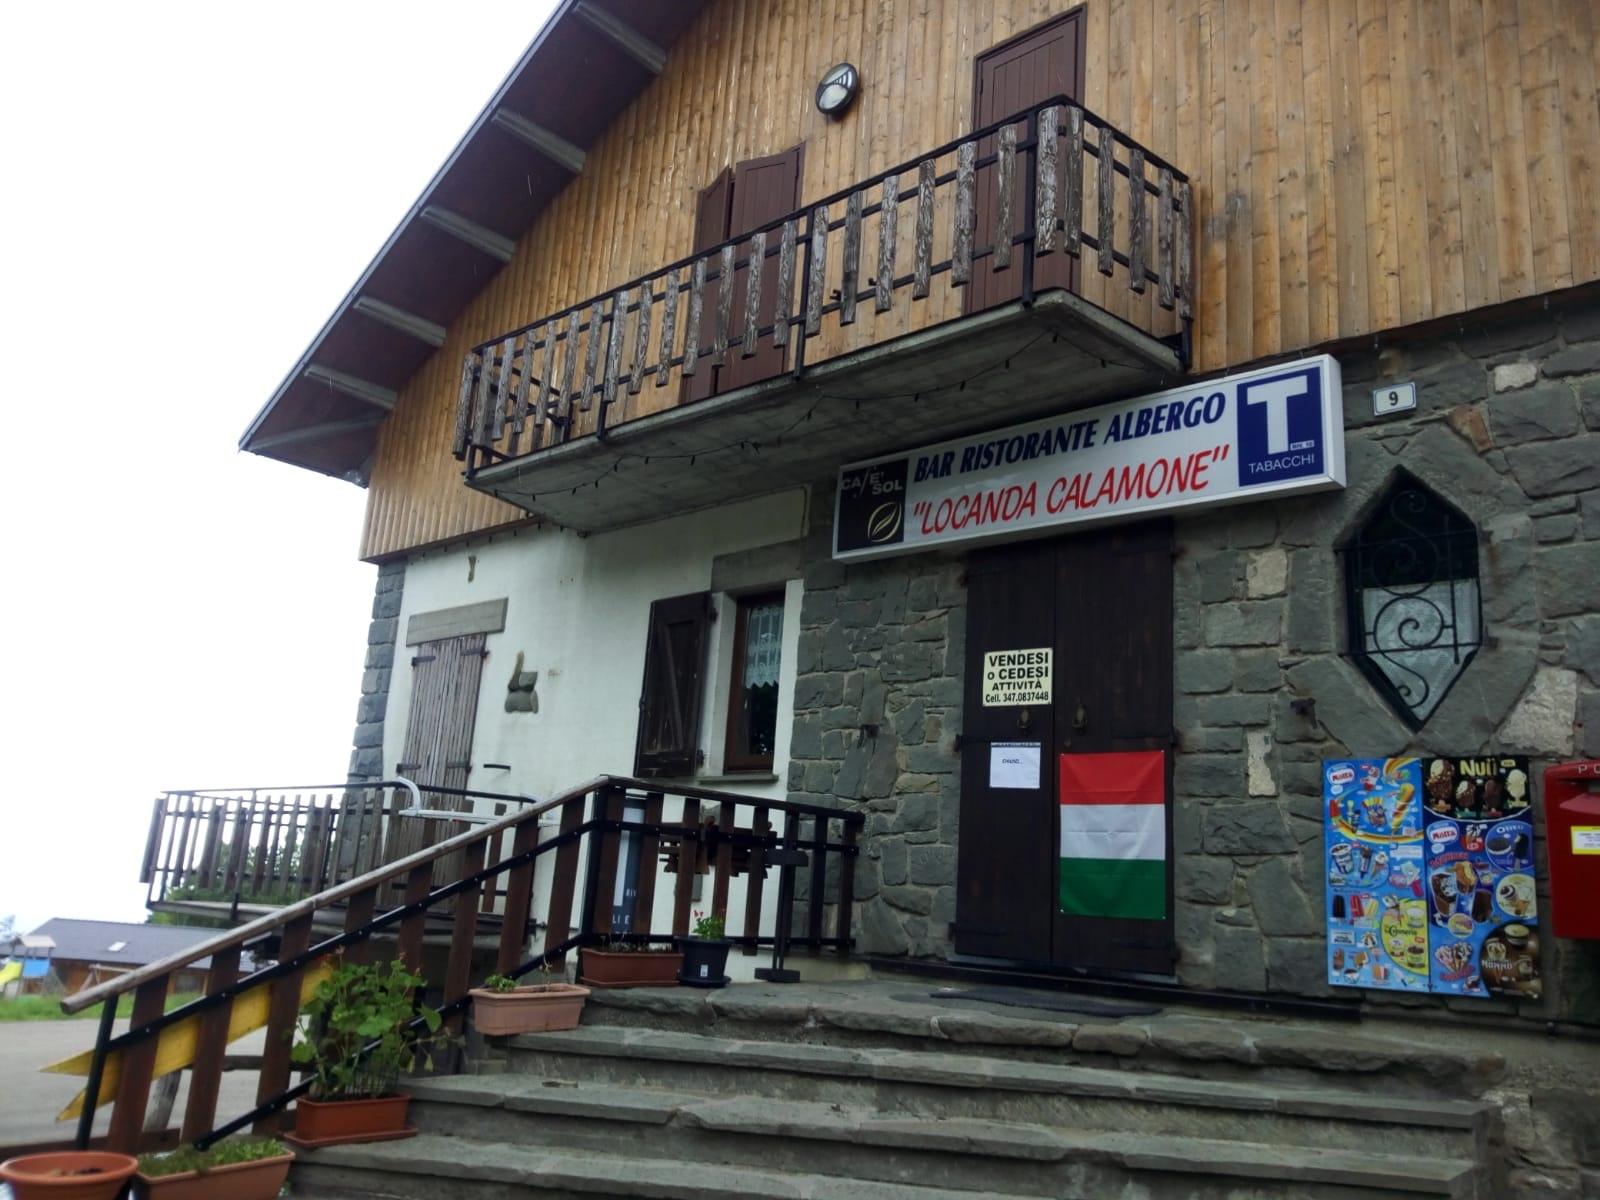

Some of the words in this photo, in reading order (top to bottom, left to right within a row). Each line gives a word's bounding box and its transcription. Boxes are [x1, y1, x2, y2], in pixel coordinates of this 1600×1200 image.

[1388, 391, 1400, 406] 9
[1246, 375, 1308, 455] T
[913, 454, 956, 483] BAR
[960, 419, 1099, 473] RISTORANTE
[1103, 391, 1227, 444] ALBERGO
[1248, 453, 1315, 474] TABACCHI
[872, 479, 904, 496] SOL
[913, 485, 1036, 535] "LOCANDA
[1046, 444, 1231, 514] CALAMONE"
[988, 652, 1049, 667] VENDESI
[998, 666, 1049, 680] CEDESI
[992, 679, 1043, 691] ATTIVITÀ
[985, 693, 1001, 703] Cell.
[1002, 691, 1049, 703] 347.0837448
